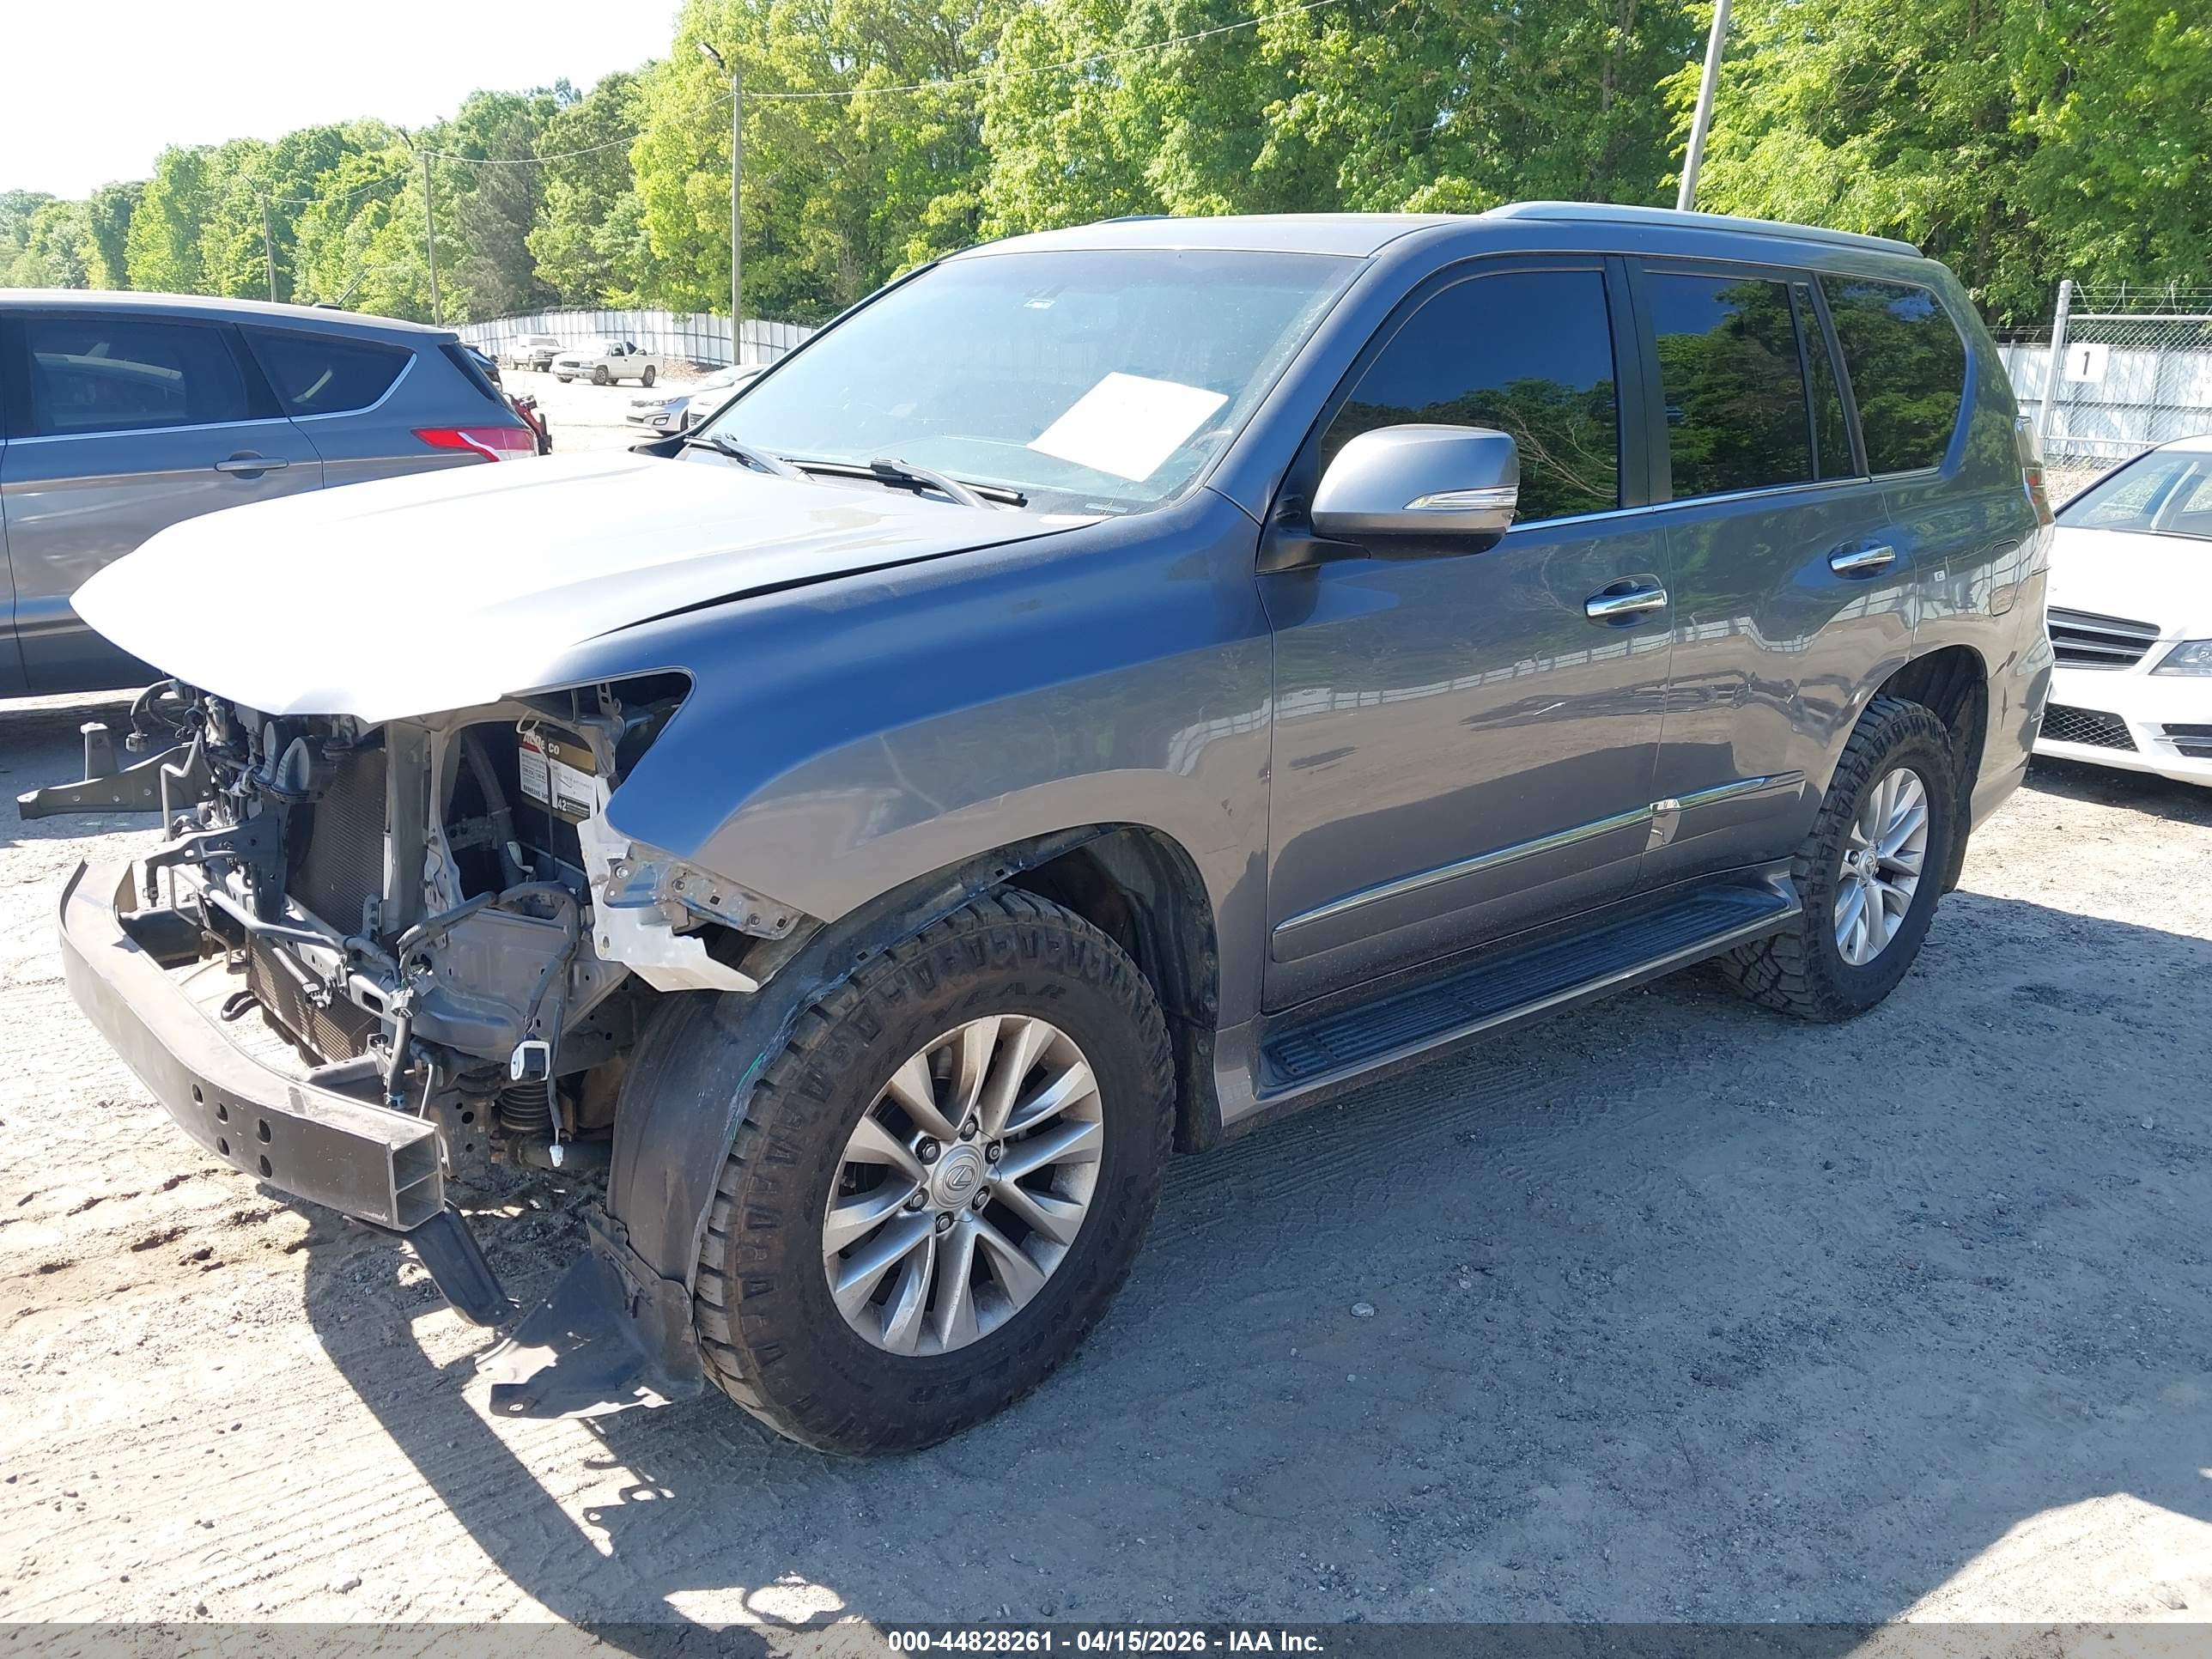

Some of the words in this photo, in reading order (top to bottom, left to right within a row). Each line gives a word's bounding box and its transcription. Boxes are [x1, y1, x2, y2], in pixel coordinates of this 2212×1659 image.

[2083, 350, 2091, 376] 1
[523, 734, 560, 755] ACDeco
[557, 798, 567, 811] 42
